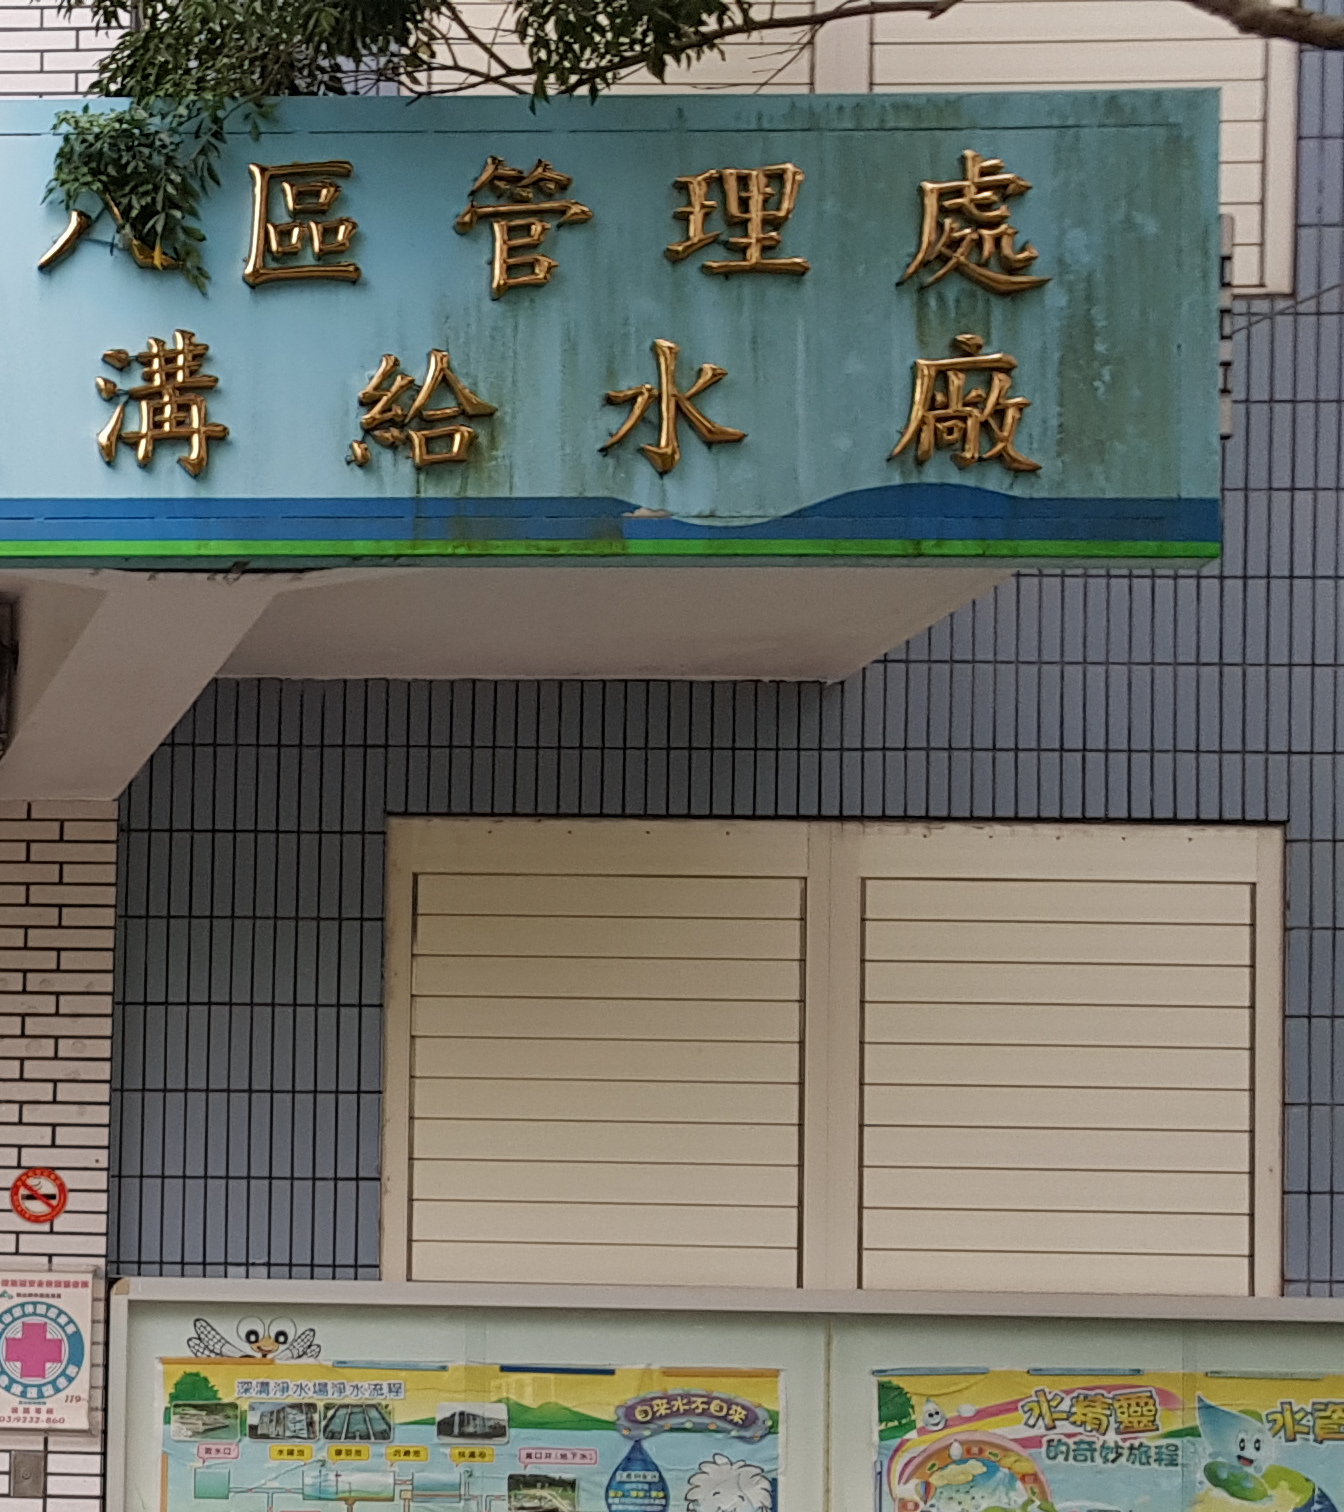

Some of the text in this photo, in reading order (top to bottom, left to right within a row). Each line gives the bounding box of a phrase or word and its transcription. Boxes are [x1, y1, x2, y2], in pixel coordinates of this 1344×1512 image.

[634, 1395, 748, 1425] 自來水不自來
[1023, 1389, 1159, 1434] 水精靈
[1044, 1438, 1180, 1468] 的奇妙旅程
